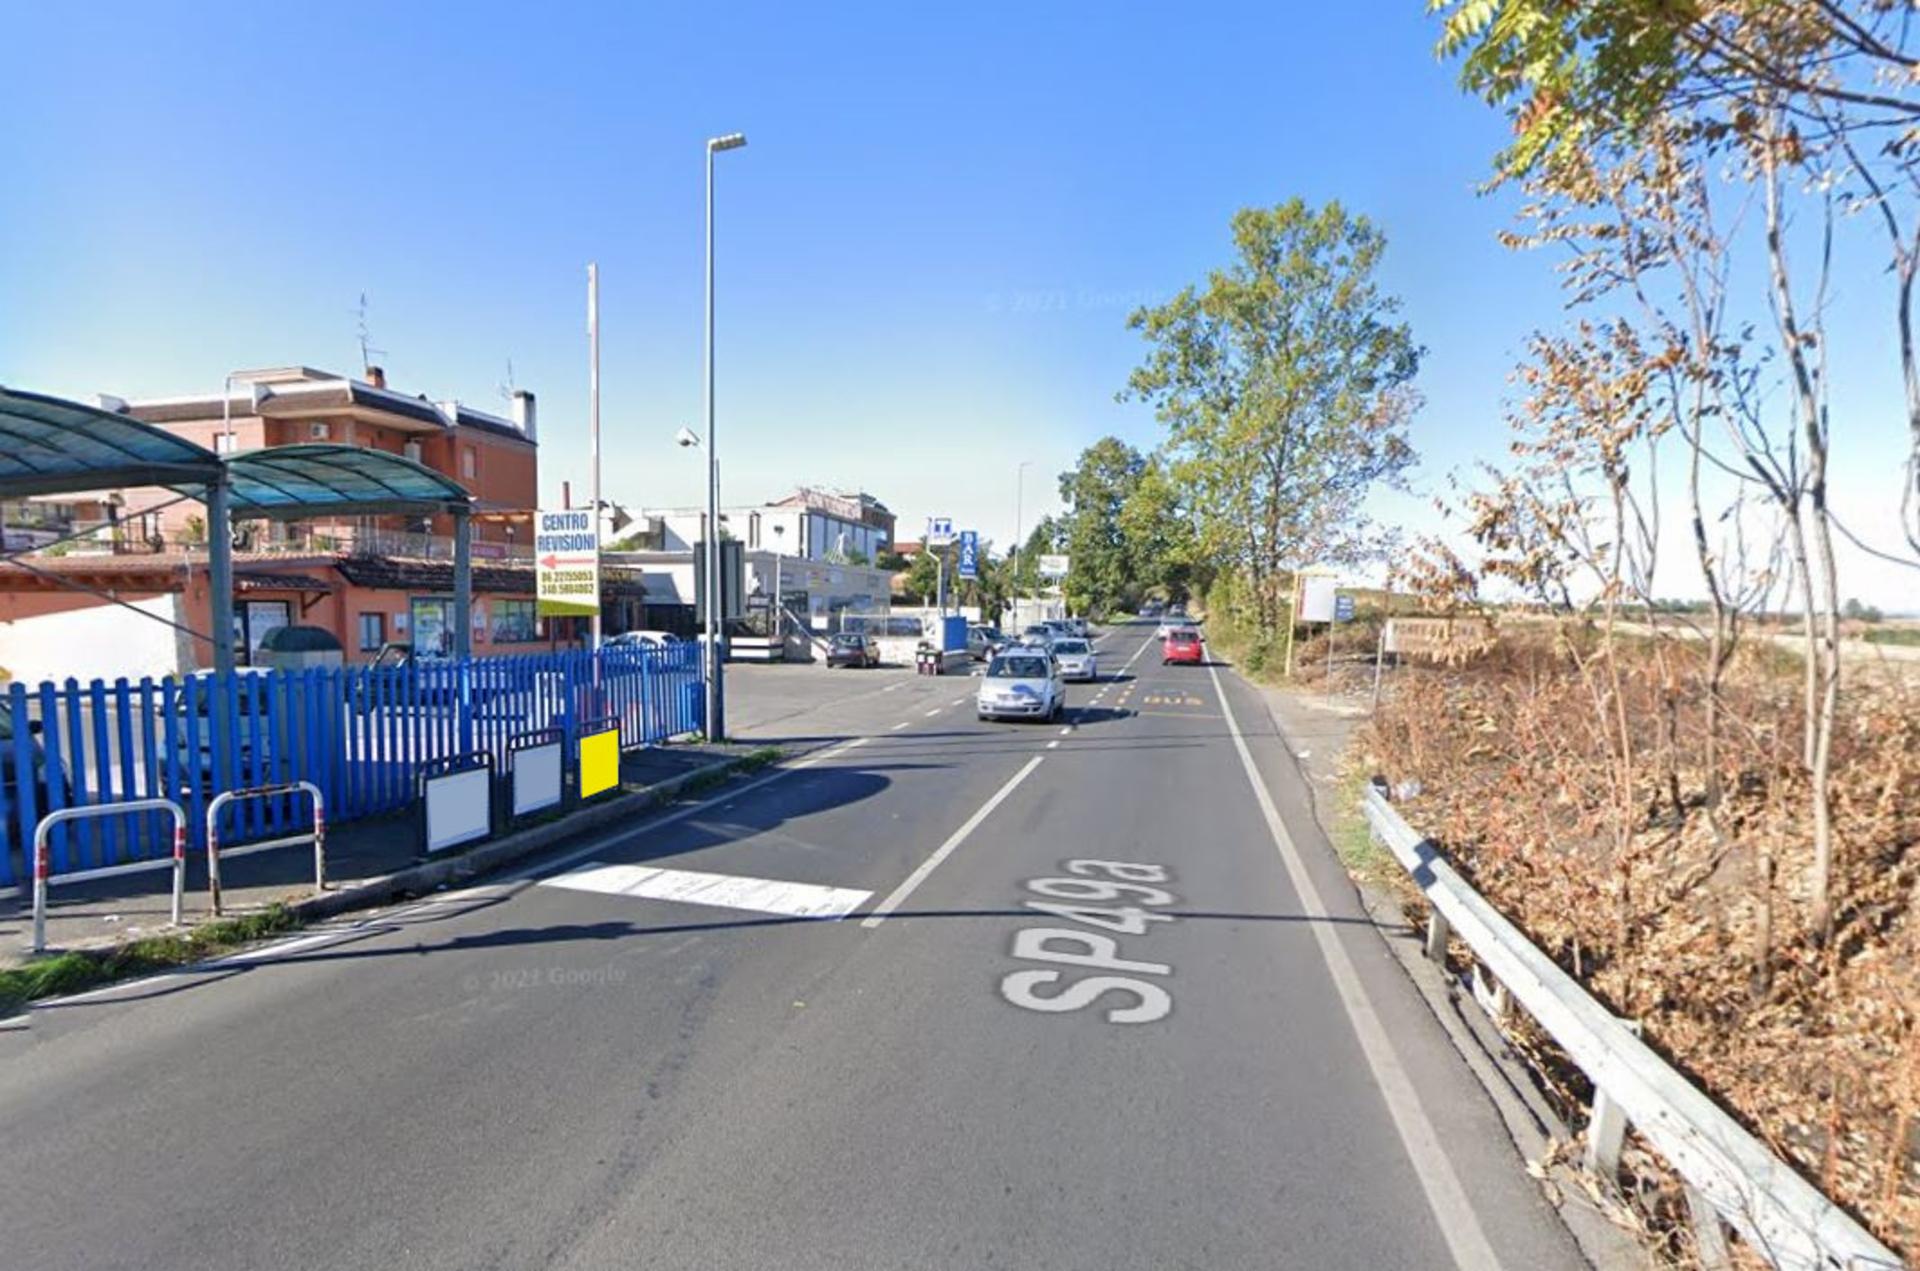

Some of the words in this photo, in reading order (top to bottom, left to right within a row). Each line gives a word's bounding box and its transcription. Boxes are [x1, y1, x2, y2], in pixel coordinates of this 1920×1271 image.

[542, 513, 588, 531] CENTRO
[538, 534, 595, 551] REVISIONI
[962, 533, 975, 566] BAR
